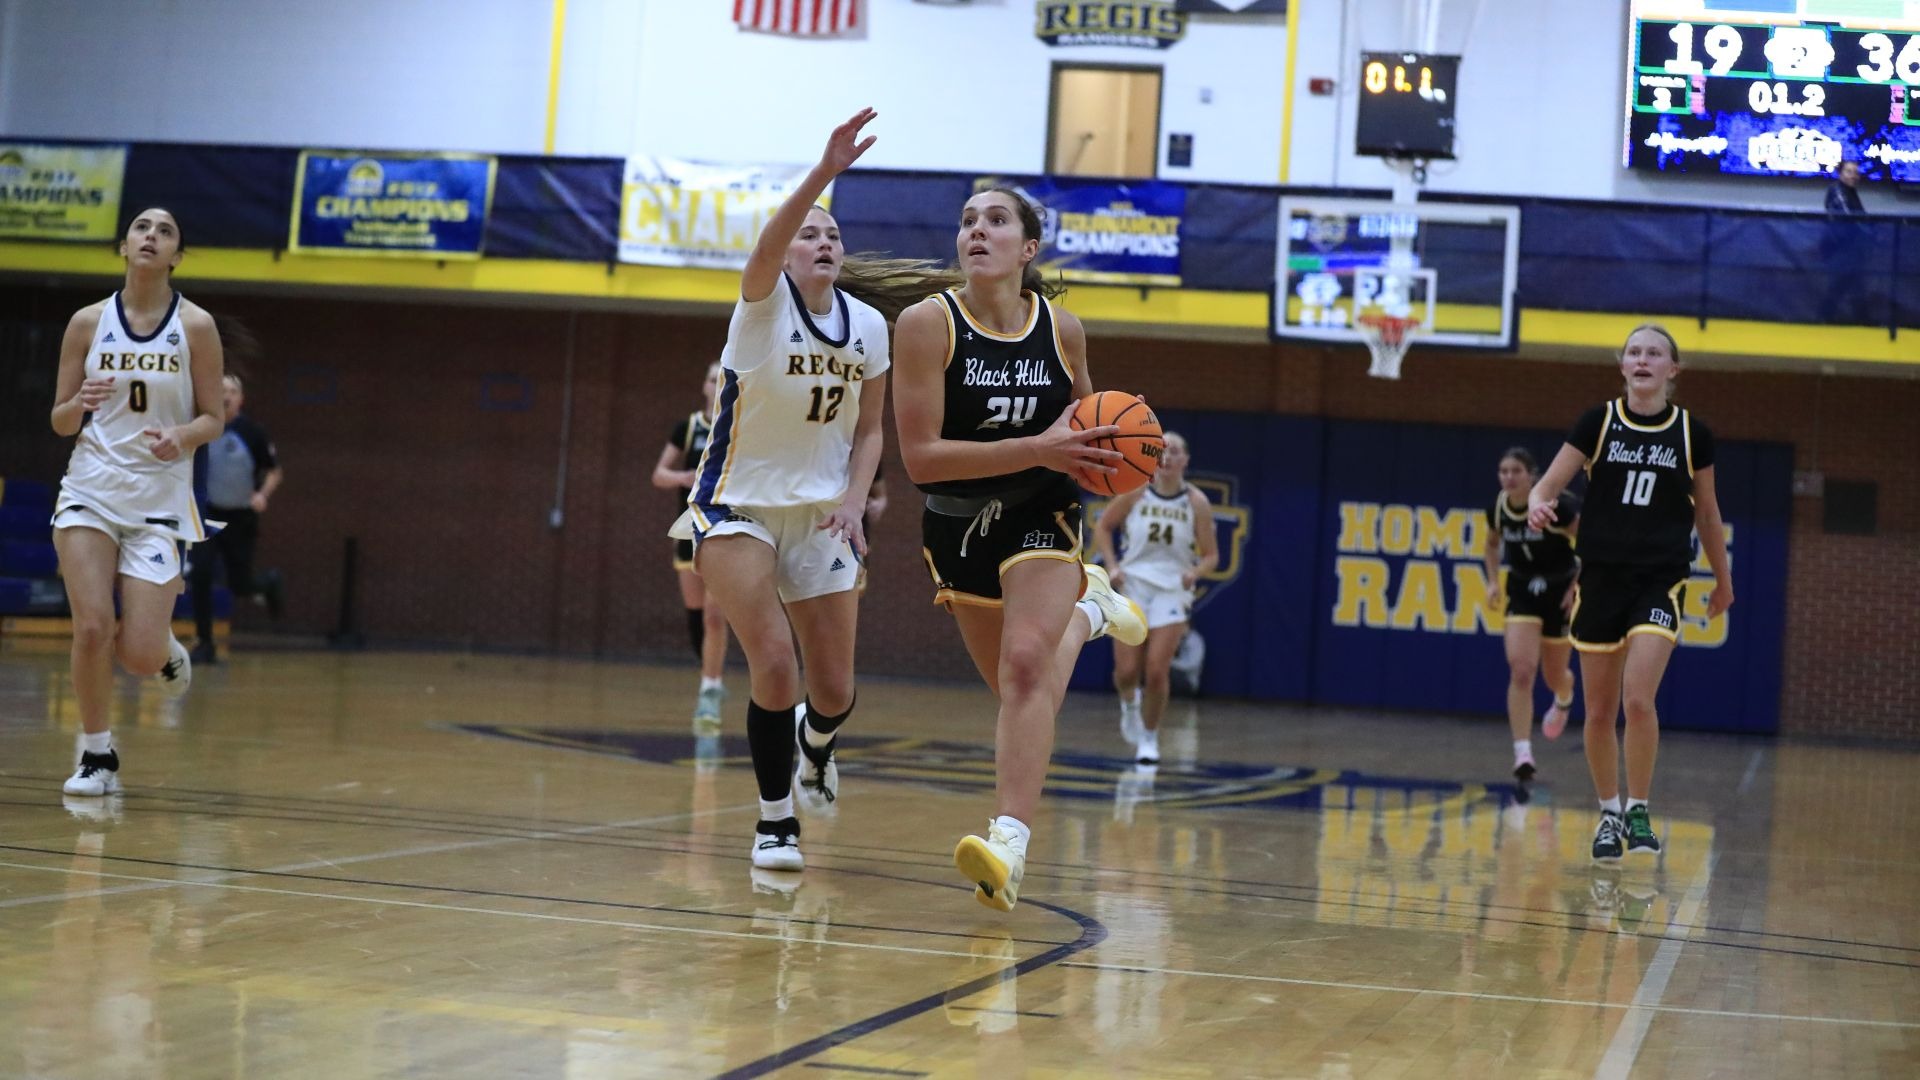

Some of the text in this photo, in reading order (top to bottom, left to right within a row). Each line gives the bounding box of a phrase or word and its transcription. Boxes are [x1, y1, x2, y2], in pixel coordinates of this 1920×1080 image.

[1045, 3, 1181, 34] REGIS
[1664, 22, 1743, 75] 19
[1856, 32, 1920, 84] 36
[1748, 81, 1826, 116] 01.2
[316, 195, 470, 222] CHAMPIONS
[1056, 229, 1180, 257] CHAMPIONS
[97, 352, 181, 373] REGIS
[785, 353, 864, 383] REGIS
[962, 357, 1052, 387] Black Hills
[129, 379, 148, 413] 0
[806, 385, 845, 424] 12
[976, 396, 1038, 430] 24
[1606, 440, 1678, 469] Black Hills
[1621, 469, 1657, 506] 10
[1148, 522, 1173, 545] 24
[1649, 607, 1672, 628] BH
